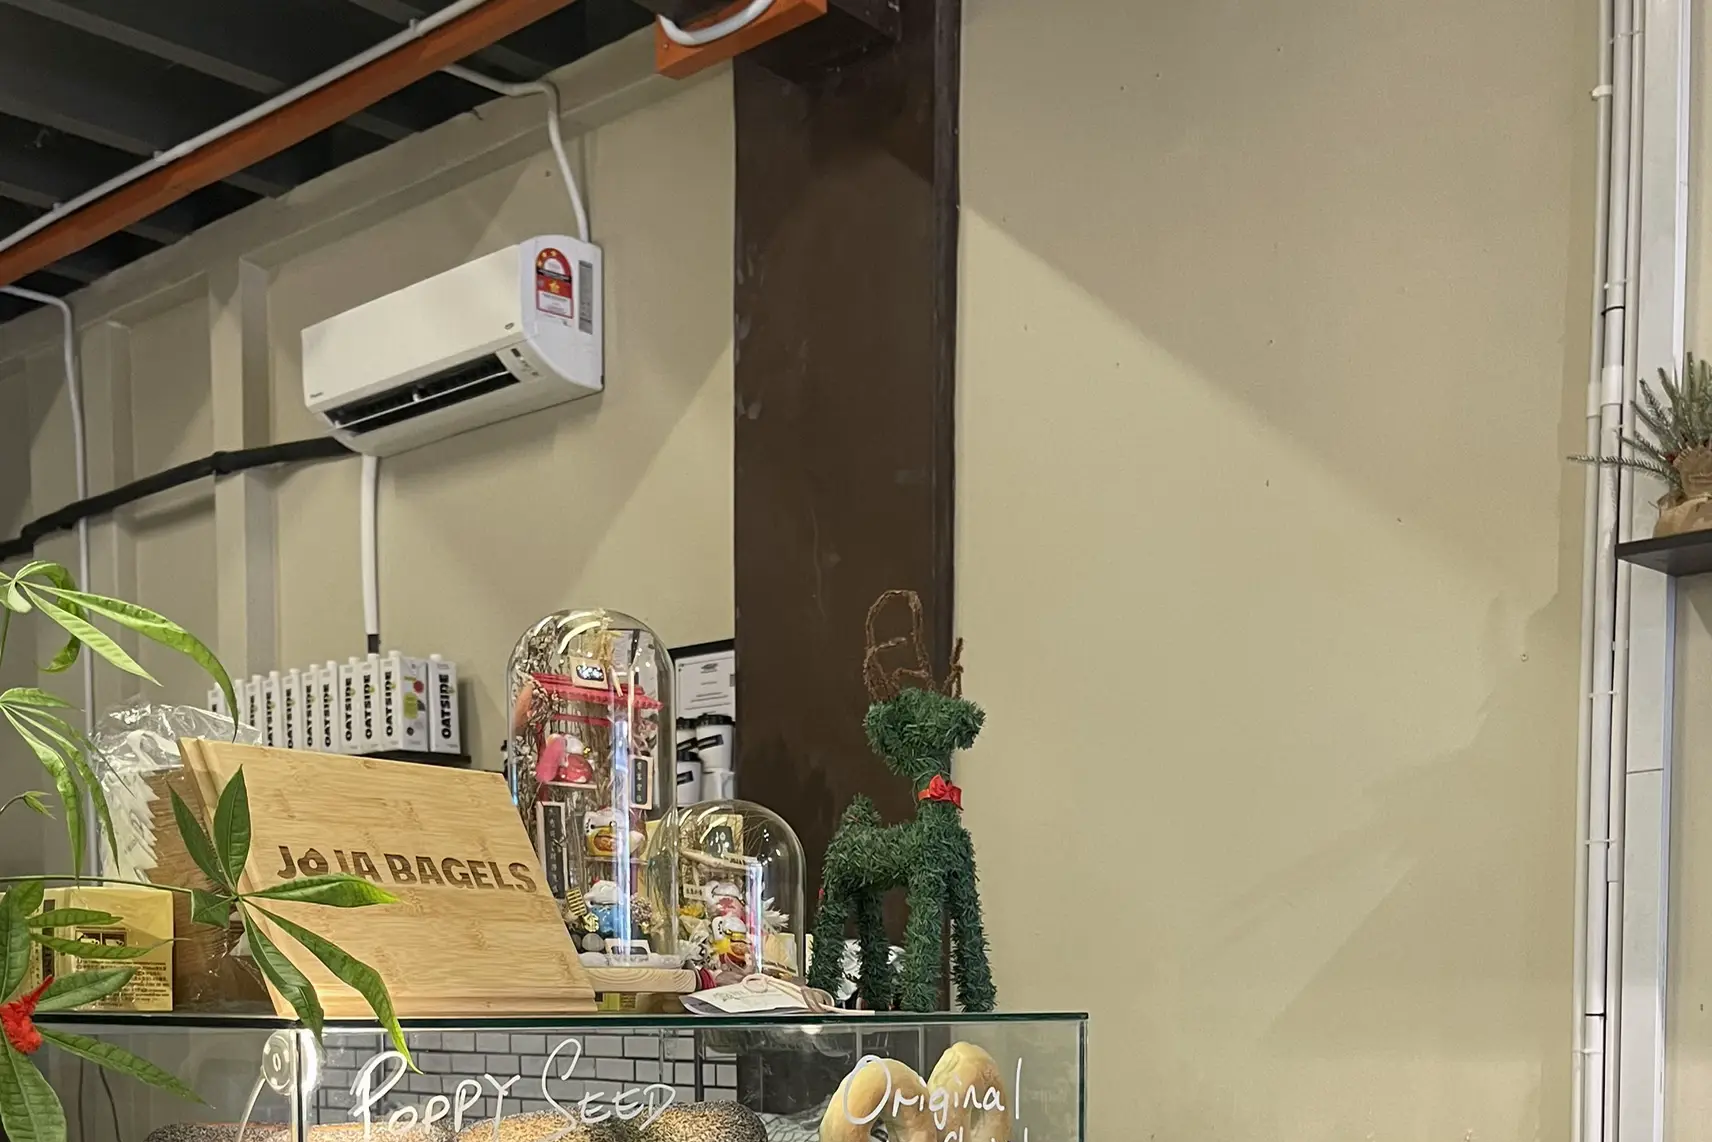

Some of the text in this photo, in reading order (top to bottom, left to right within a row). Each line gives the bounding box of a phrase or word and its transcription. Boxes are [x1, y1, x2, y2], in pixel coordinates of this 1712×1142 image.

[305, 684, 313, 747] OATSIDE
[323, 684, 331, 747] OATSIDE
[345, 677, 353, 742] OATSIDE
[363, 675, 373, 740] OATSIDE
[385, 671, 393, 737] OATSIDE
[438, 674, 452, 740] OATSIDE
[384, 853, 538, 893] BAGELS
[842, 1055, 1023, 1130] Original
